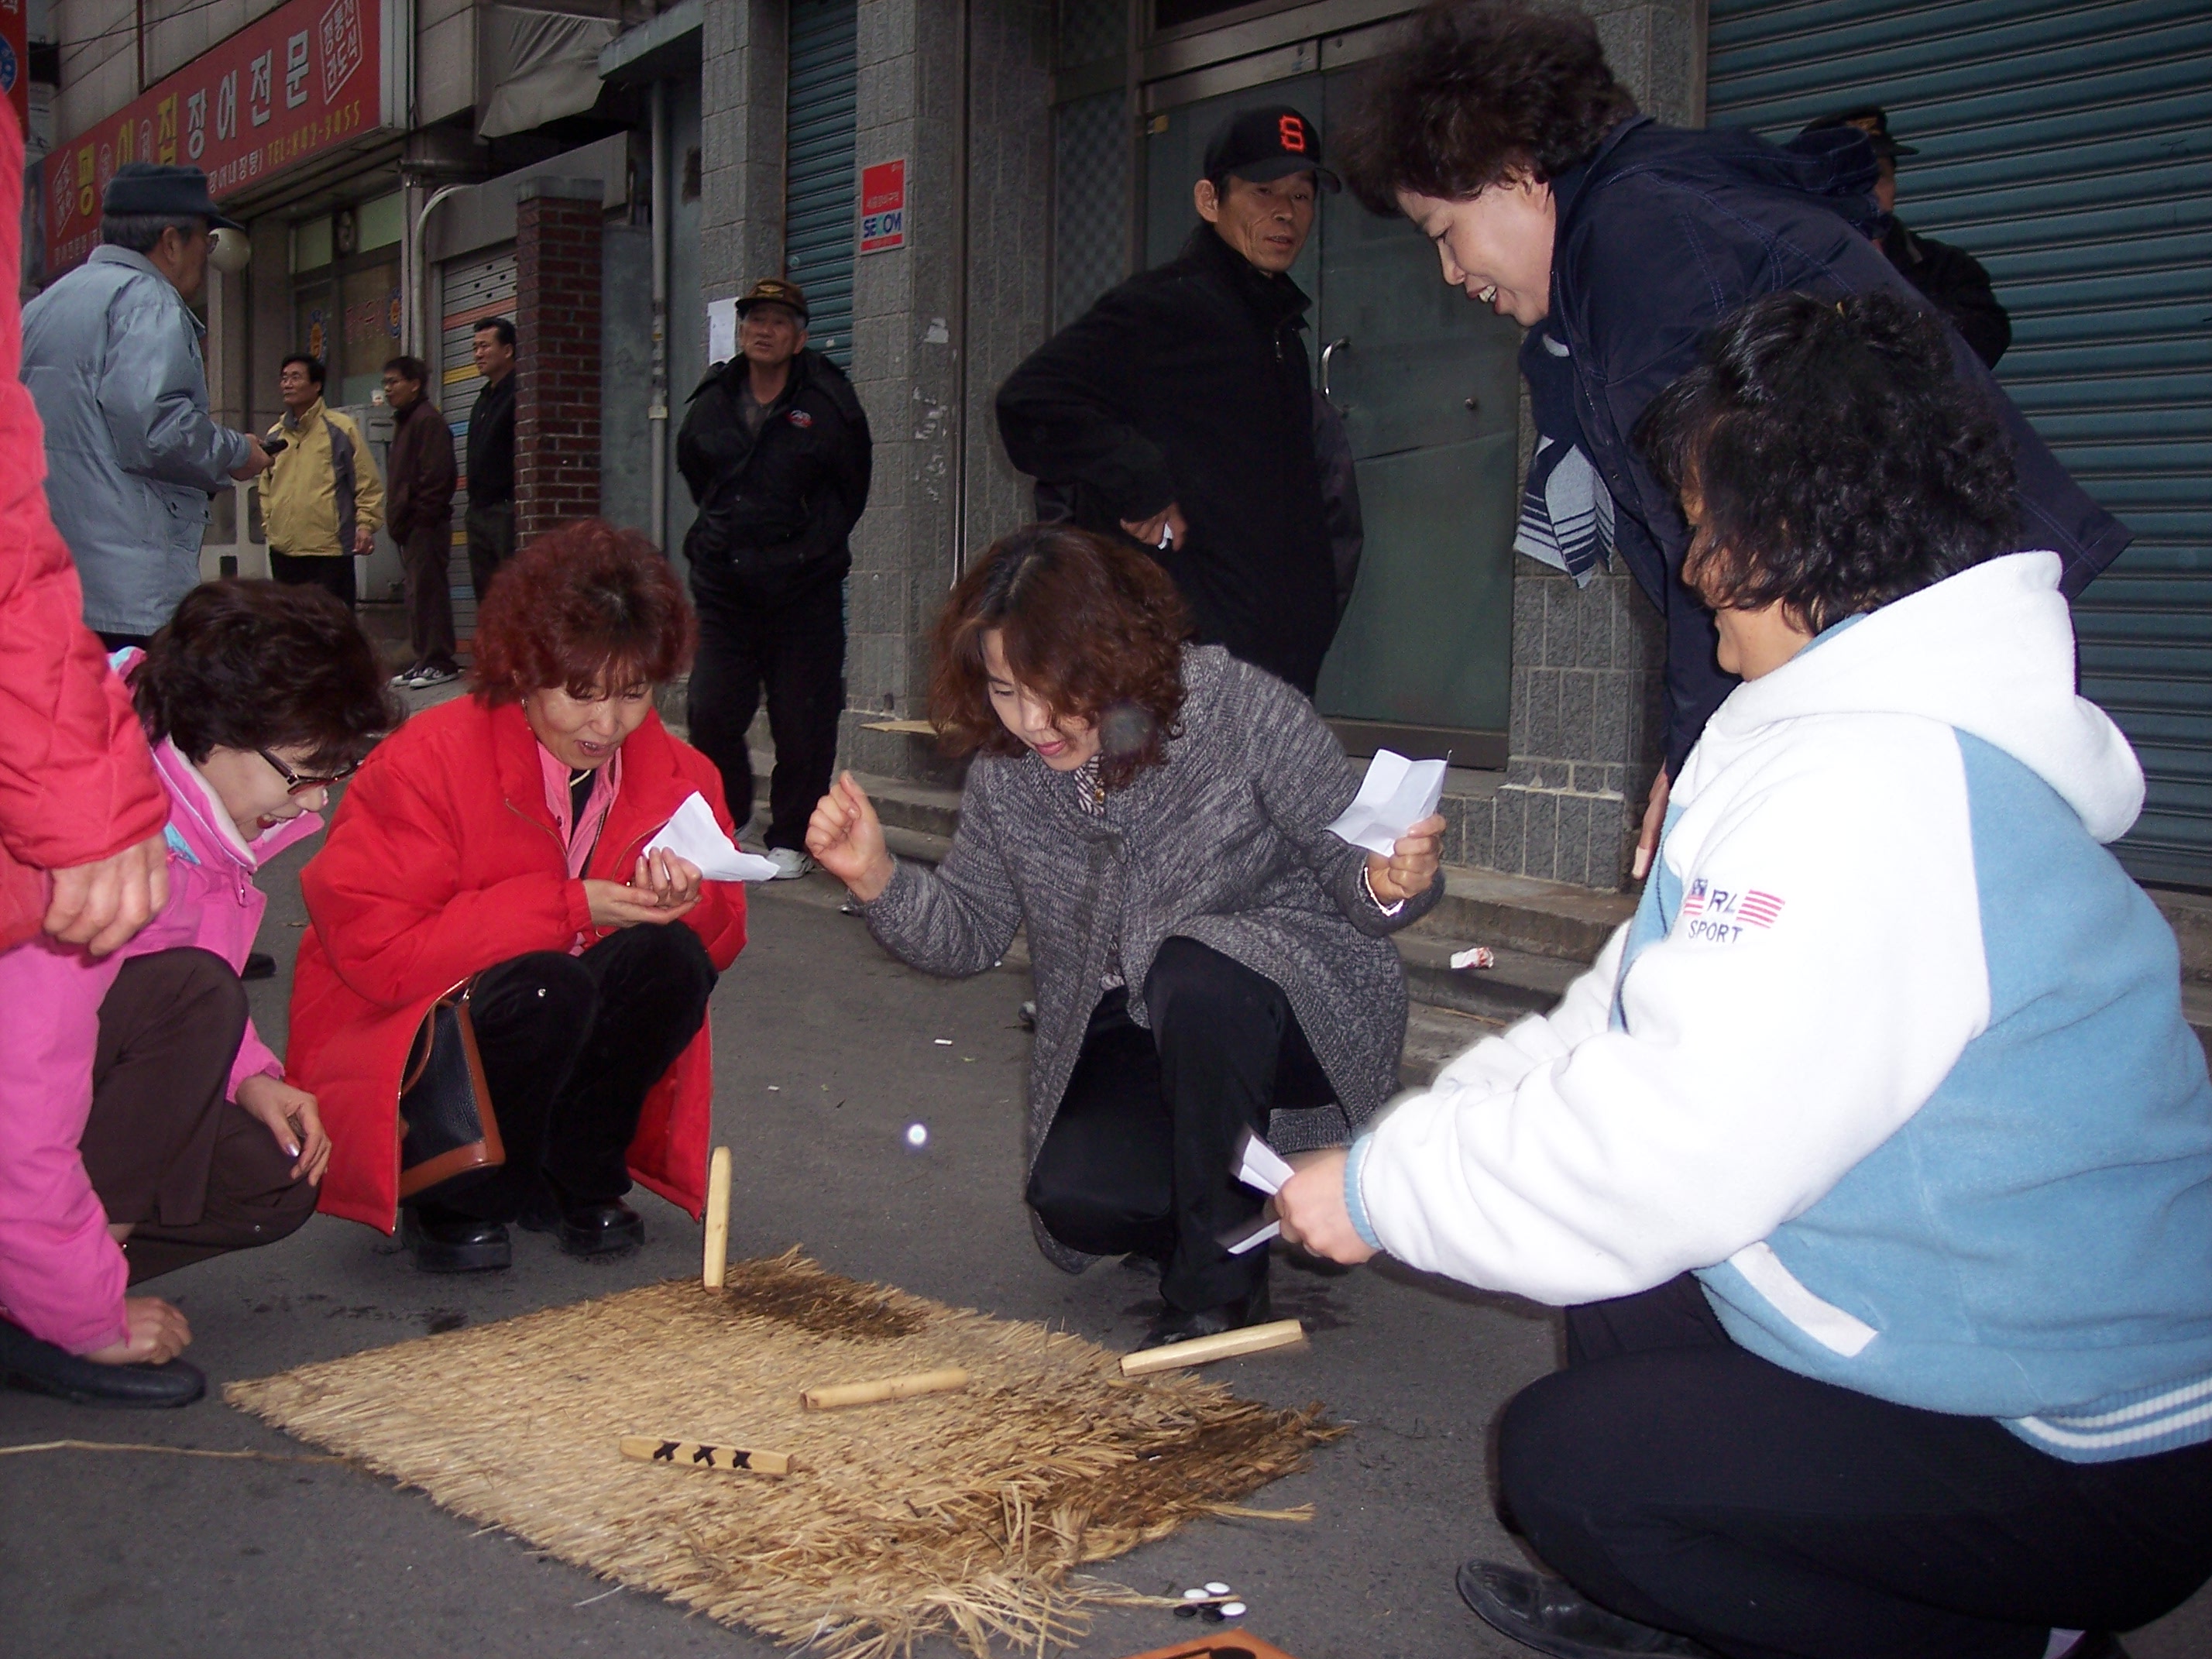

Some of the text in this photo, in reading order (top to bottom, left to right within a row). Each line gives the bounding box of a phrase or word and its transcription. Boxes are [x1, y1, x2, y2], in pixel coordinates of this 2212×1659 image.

[187, 29, 309, 160] 장어전문
[1279, 115, 1304, 153] S
[864, 211, 902, 238] SECOM
[1688, 919, 1743, 943] SPORT
